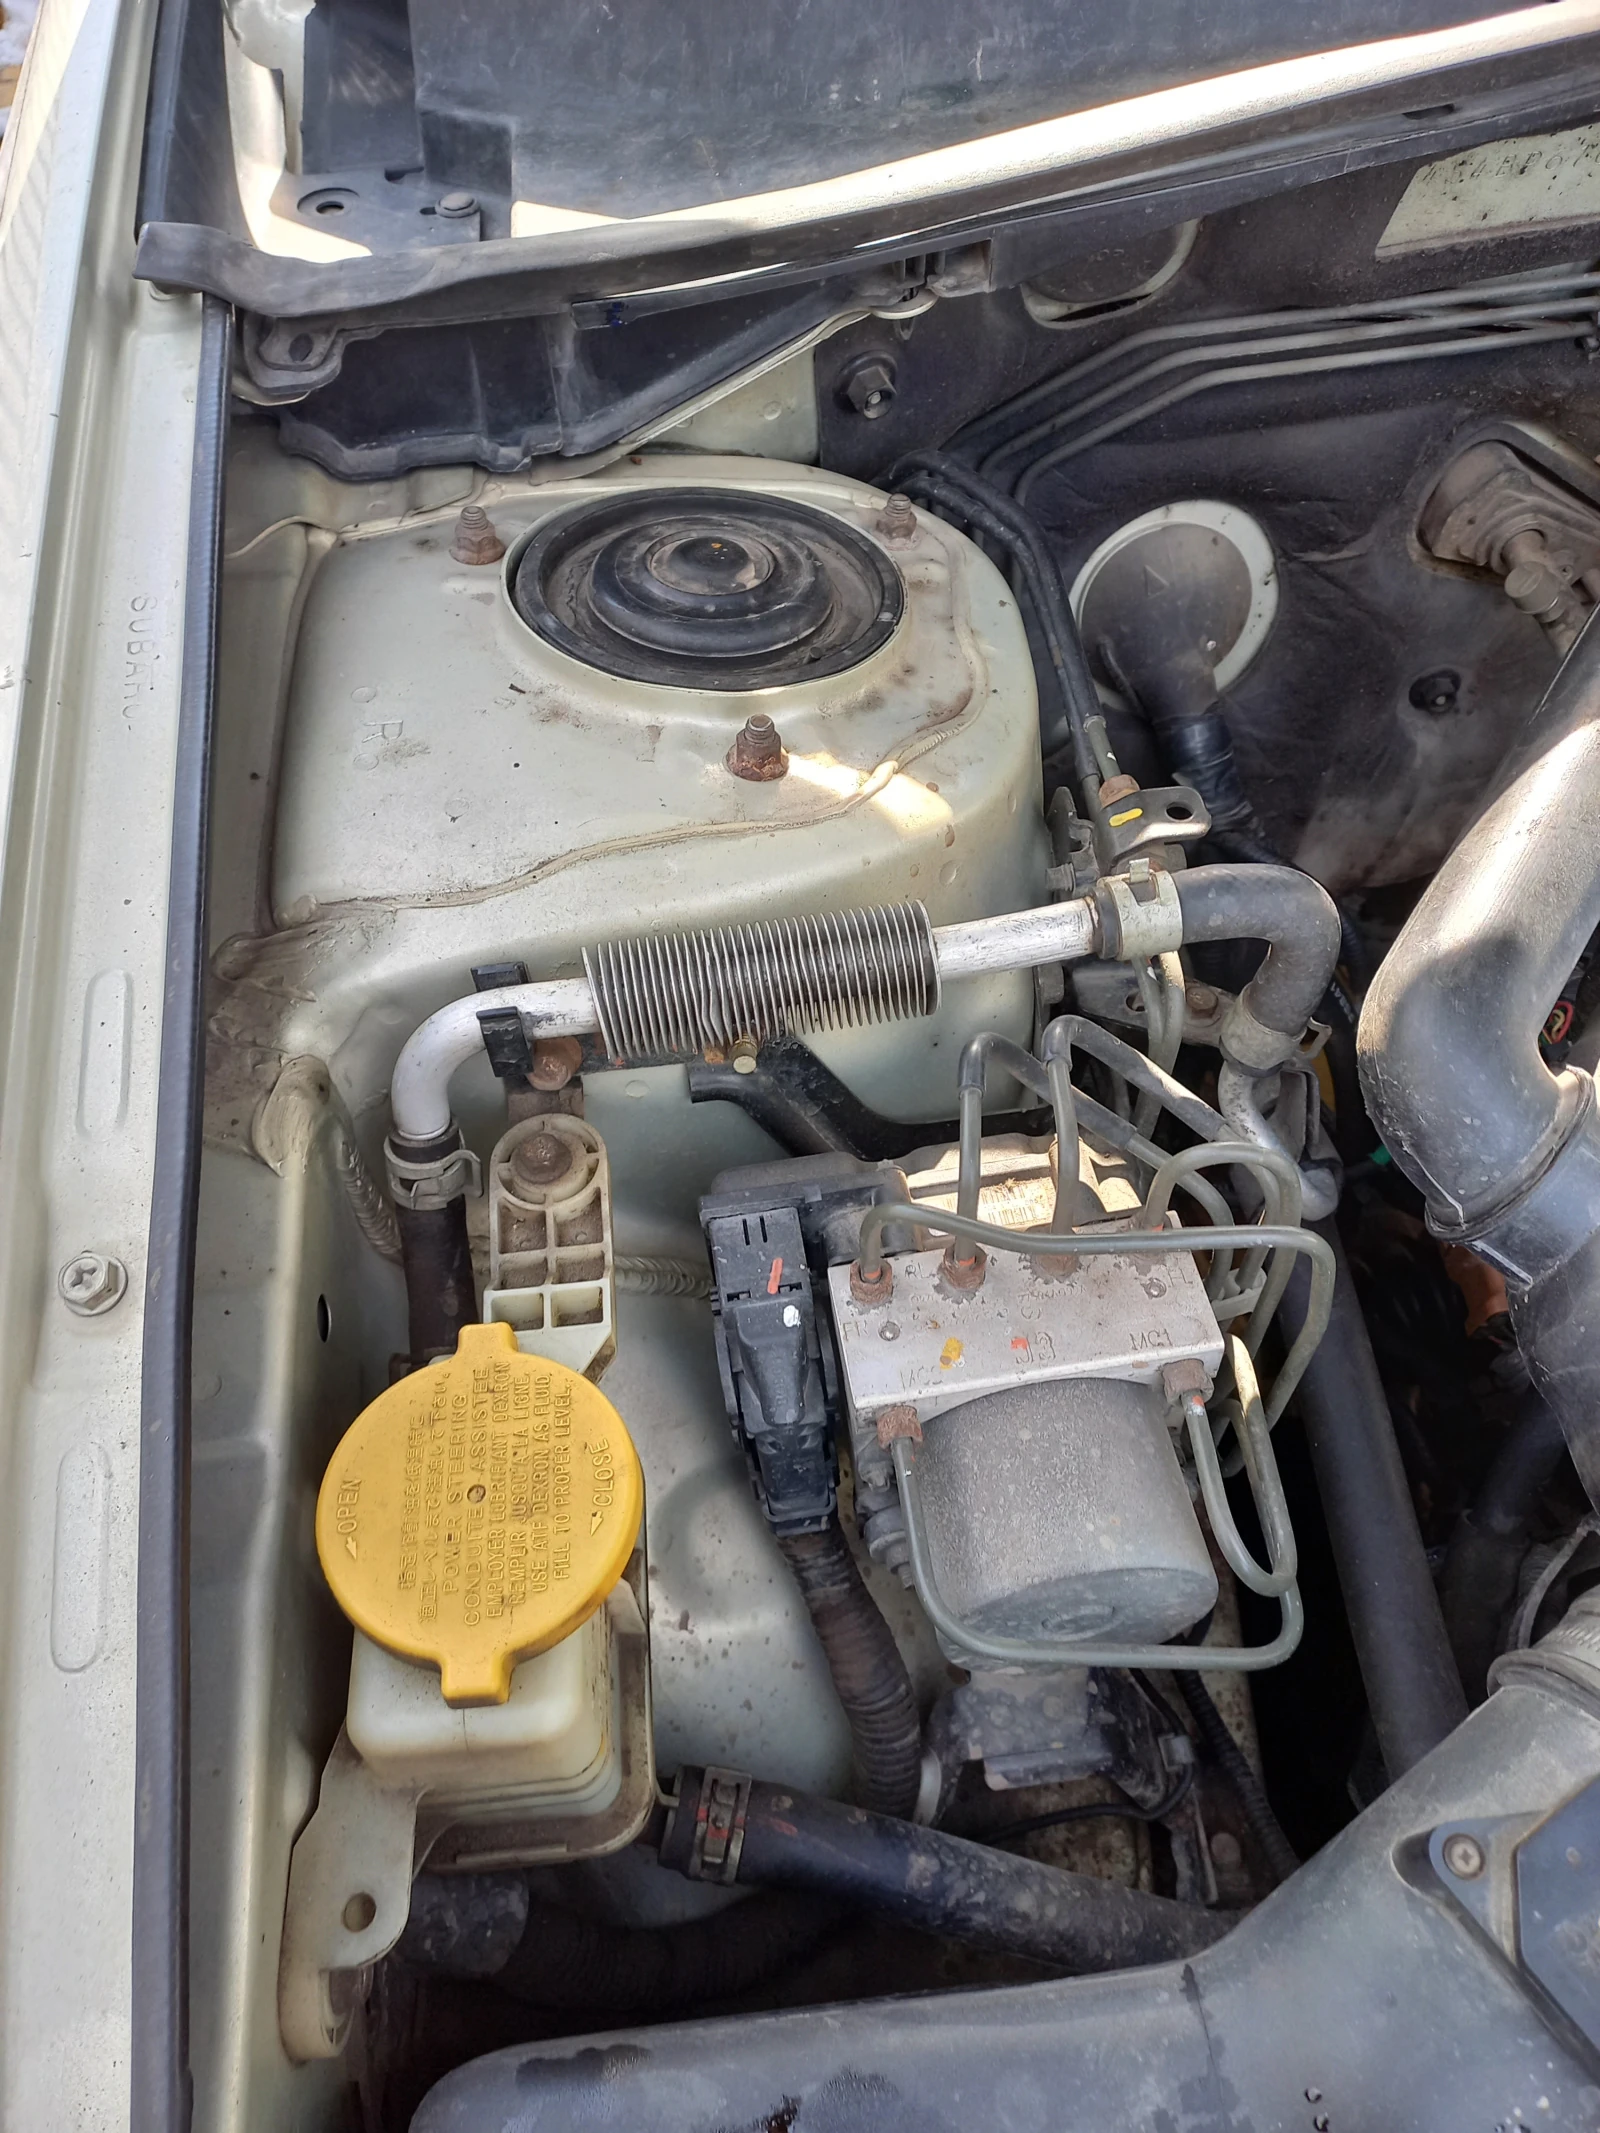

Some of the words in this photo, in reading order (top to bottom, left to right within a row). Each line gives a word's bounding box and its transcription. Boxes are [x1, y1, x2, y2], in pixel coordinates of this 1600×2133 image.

[471, 1367, 488, 1472] ASSISTEE
[493, 1362, 510, 1422] DEXRON
[447, 1394, 467, 1503] STEERING
[512, 1427, 528, 1446] LA
[533, 1423, 549, 1441] AS
[489, 1431, 507, 1521] LUBRIFIANT
[532, 1450, 549, 1512] DEXRON
[554, 1445, 570, 1505] PROPER
[589, 1437, 615, 1506] CLOSE
[337, 1479, 361, 1534] OPEN
[532, 1522, 548, 1550] ATF
[554, 1514, 570, 1534] TO
[443, 1516, 462, 1593] POWER
[464, 1507, 483, 1626] CONDUITE
[486, 1529, 505, 1617] EMPLOYER
[509, 1531, 526, 1604] REMPLIR
[531, 1561, 548, 1592] USE
[554, 1543, 570, 1579] FILL
